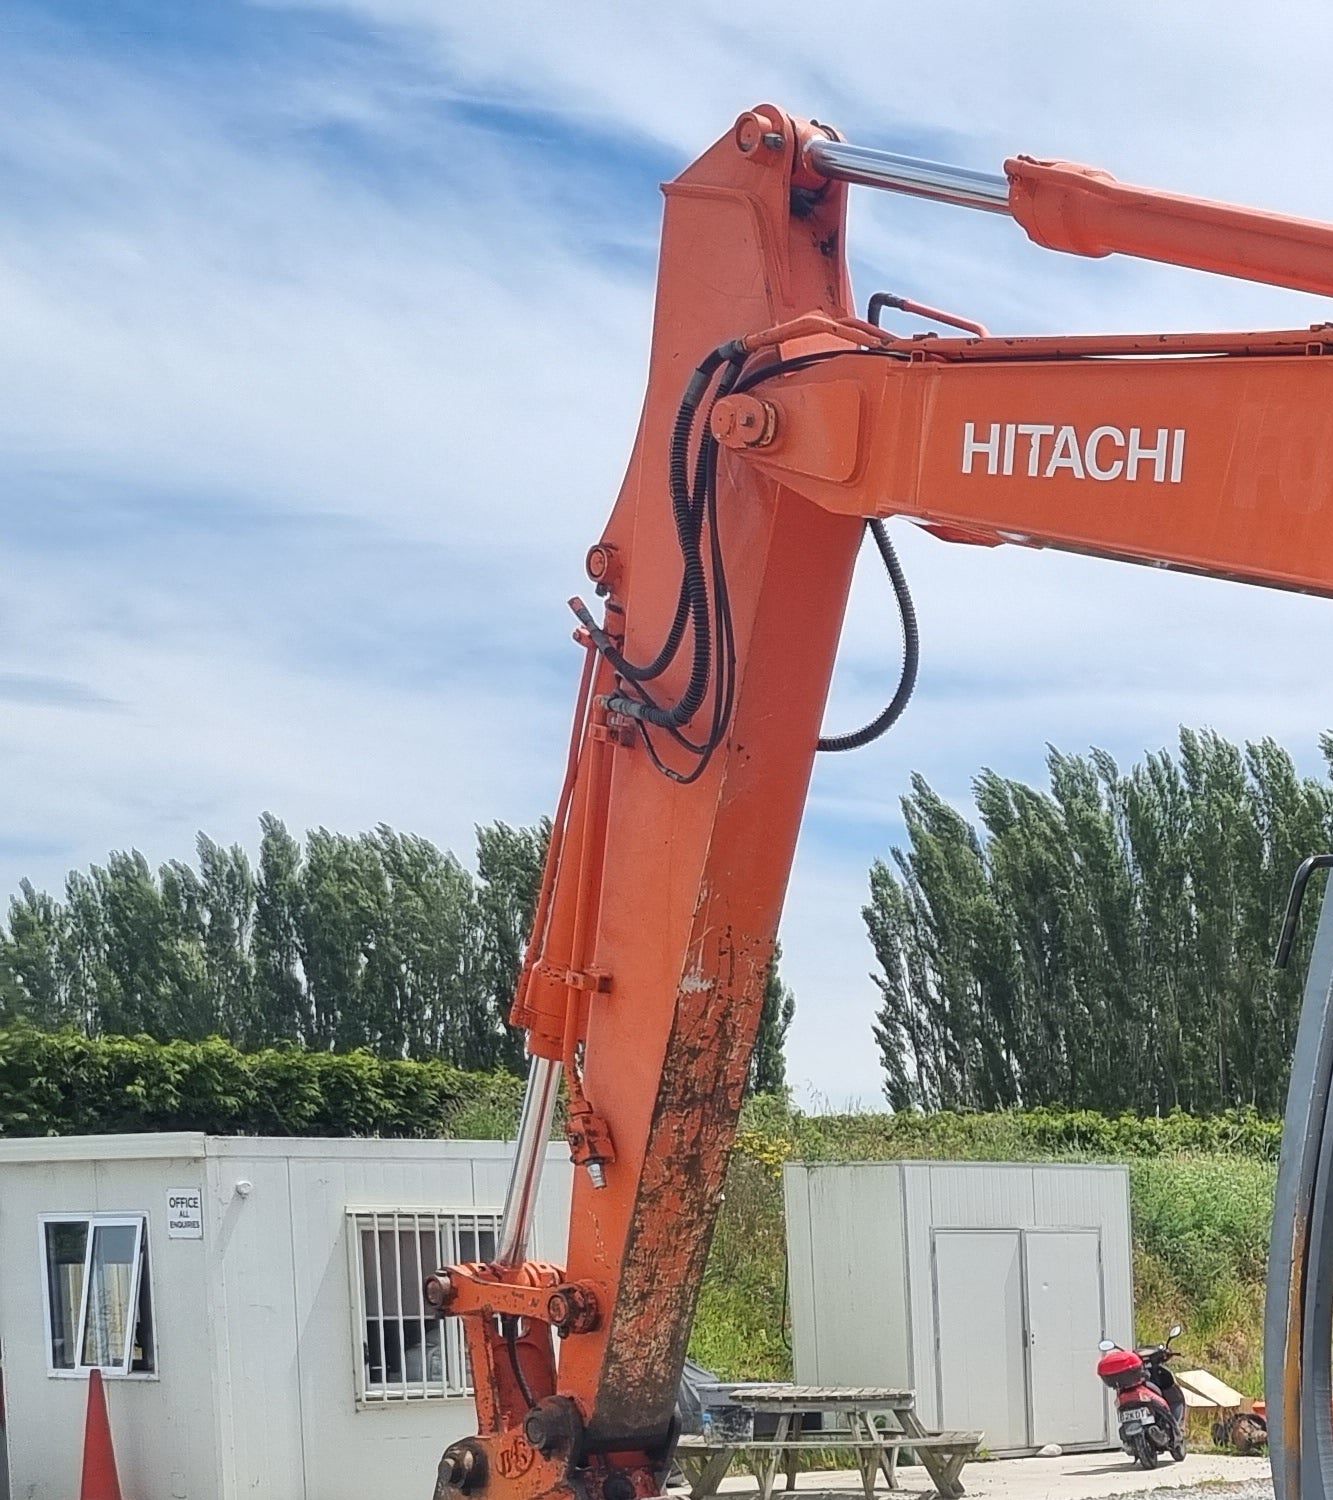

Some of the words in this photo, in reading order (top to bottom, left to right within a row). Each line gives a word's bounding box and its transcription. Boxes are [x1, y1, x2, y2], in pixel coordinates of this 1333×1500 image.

[961, 421, 1186, 483] HITACHI
[169, 1197, 199, 1208] OFFICE
[179, 1210, 190, 1218] ALL
[170, 1220, 200, 1229] ENQUIRIES
